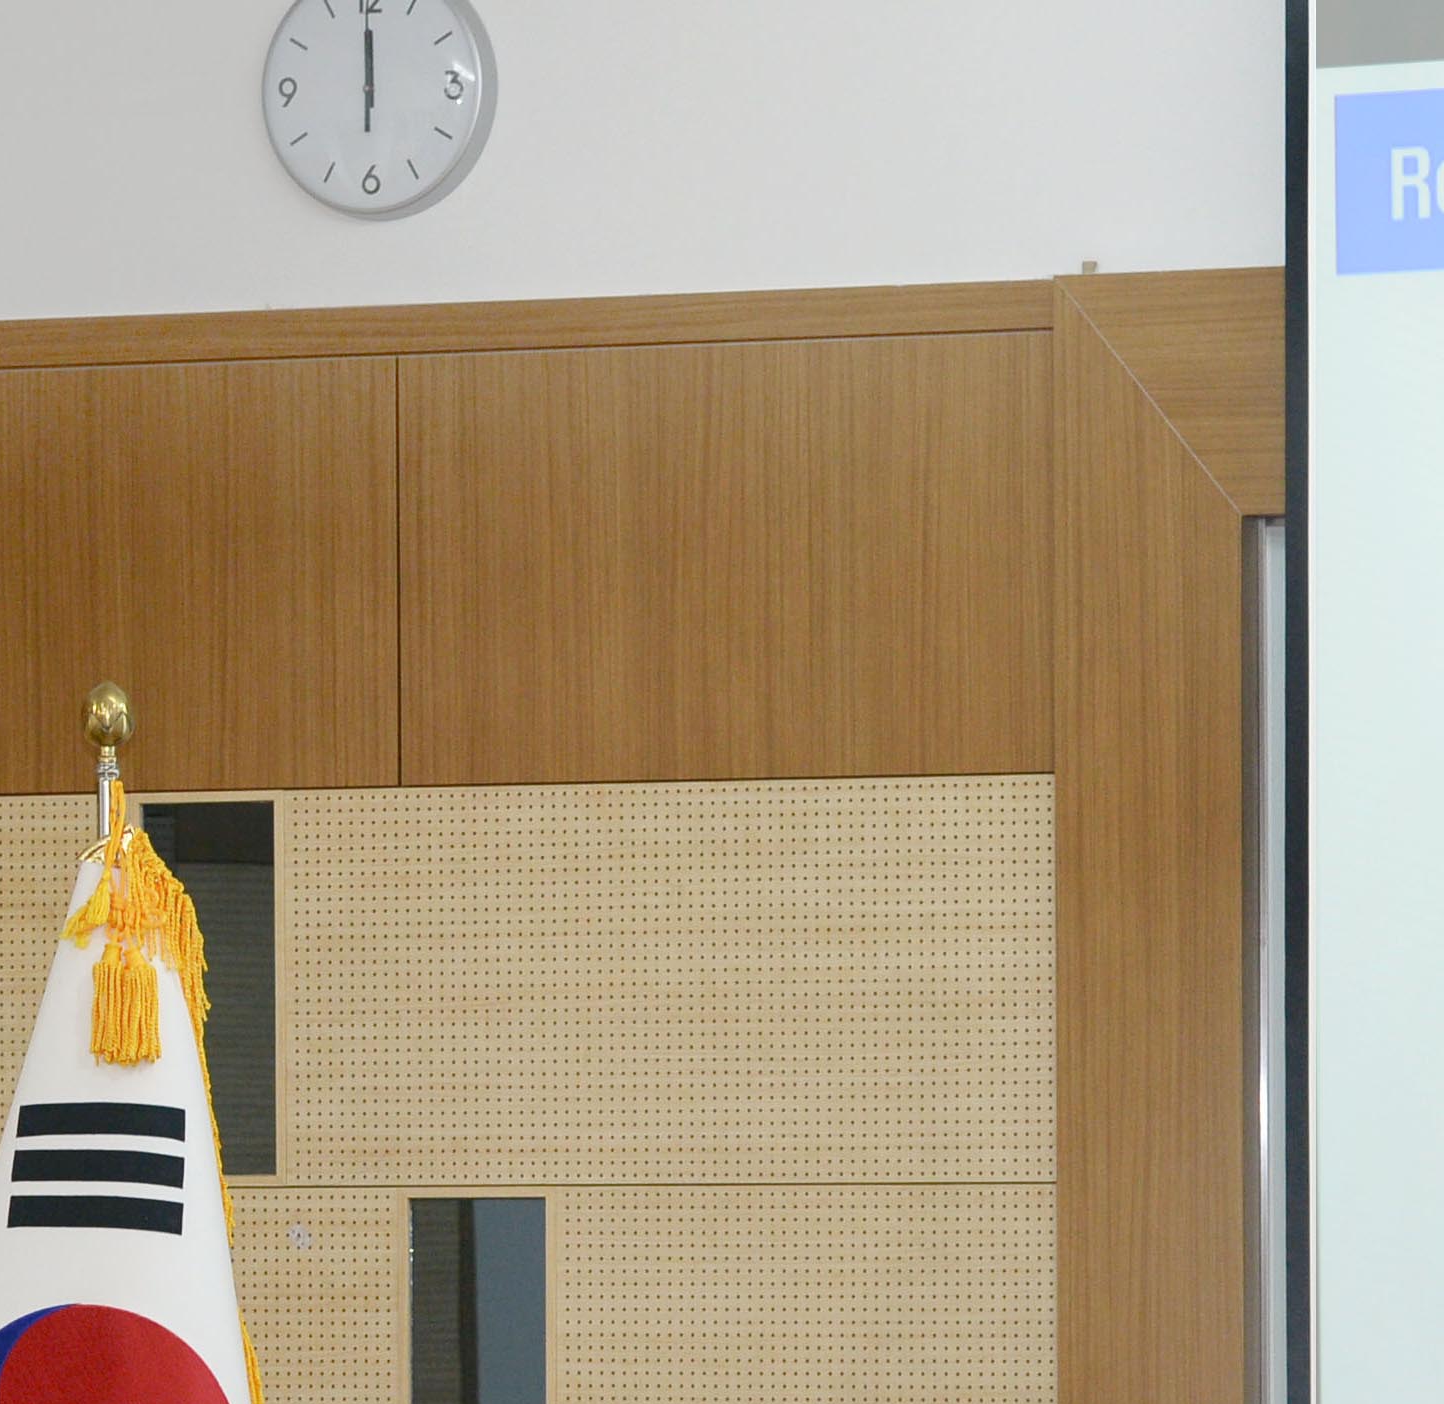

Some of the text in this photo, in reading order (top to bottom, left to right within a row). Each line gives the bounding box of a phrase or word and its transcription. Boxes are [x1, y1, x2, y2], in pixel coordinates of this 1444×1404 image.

[278, 77, 298, 108] 9
[443, 70, 465, 101] 3
[362, 164, 381, 195] 6
